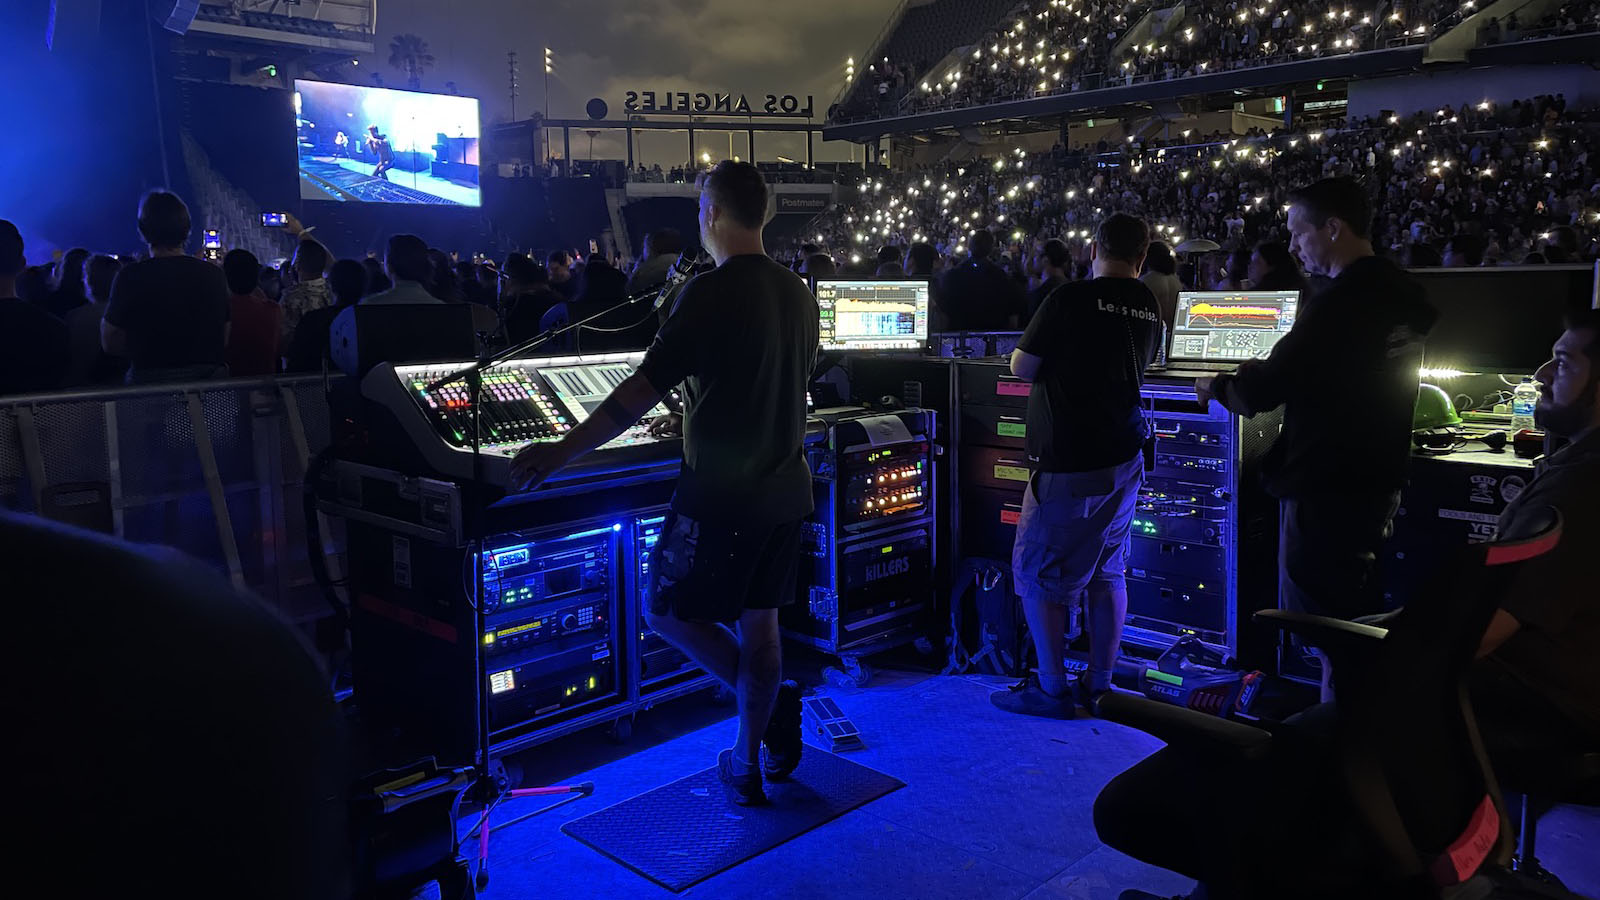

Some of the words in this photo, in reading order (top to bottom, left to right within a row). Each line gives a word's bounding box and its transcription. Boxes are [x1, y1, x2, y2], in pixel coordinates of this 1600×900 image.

[782, 198, 825, 207] Postmates
[865, 556, 910, 582] KILLERS
[1150, 685, 1181, 697] ATLAS
